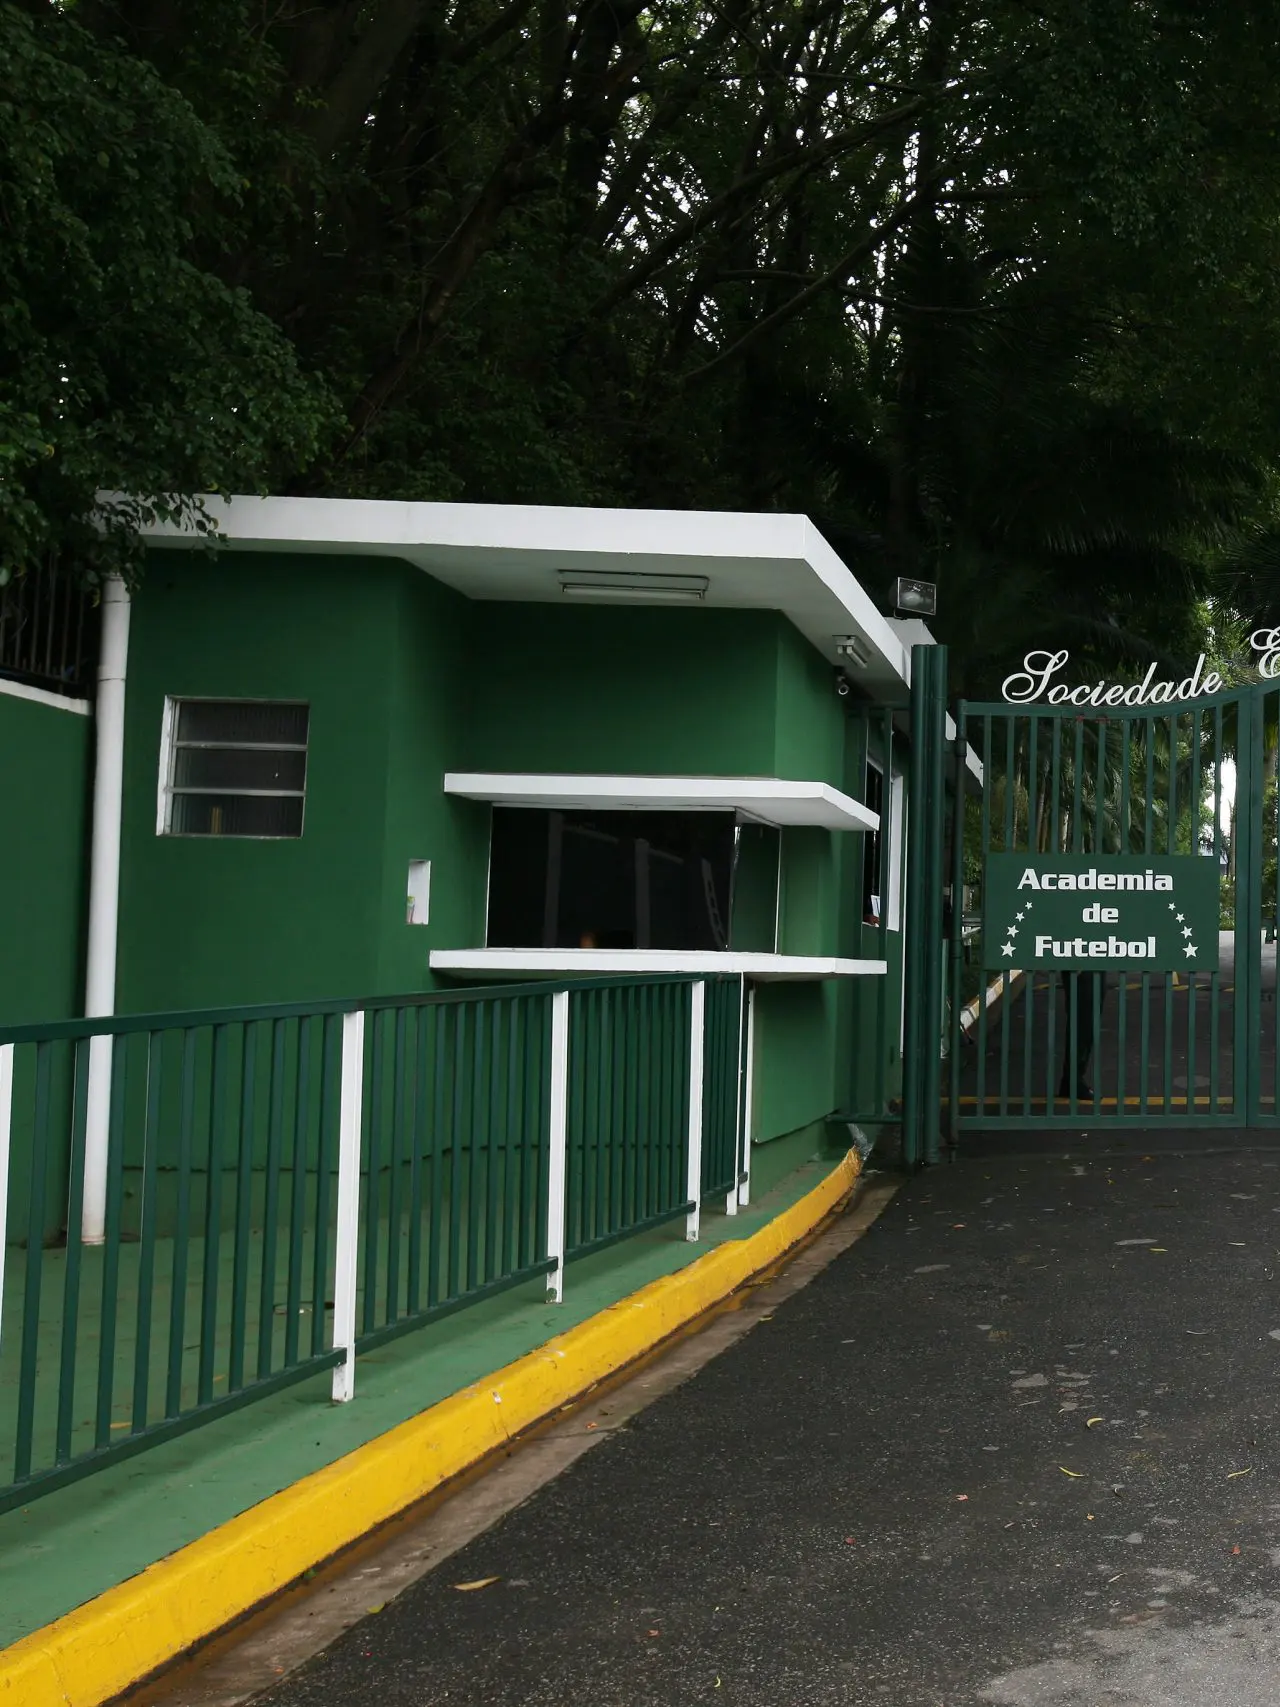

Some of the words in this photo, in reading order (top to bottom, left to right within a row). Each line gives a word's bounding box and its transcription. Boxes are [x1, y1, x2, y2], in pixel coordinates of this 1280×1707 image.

[1001, 649, 1223, 706] Sociedade
[1017, 868, 1173, 891] Academia
[1082, 902, 1119, 923] de
[1035, 935, 1156, 958] Futebol
